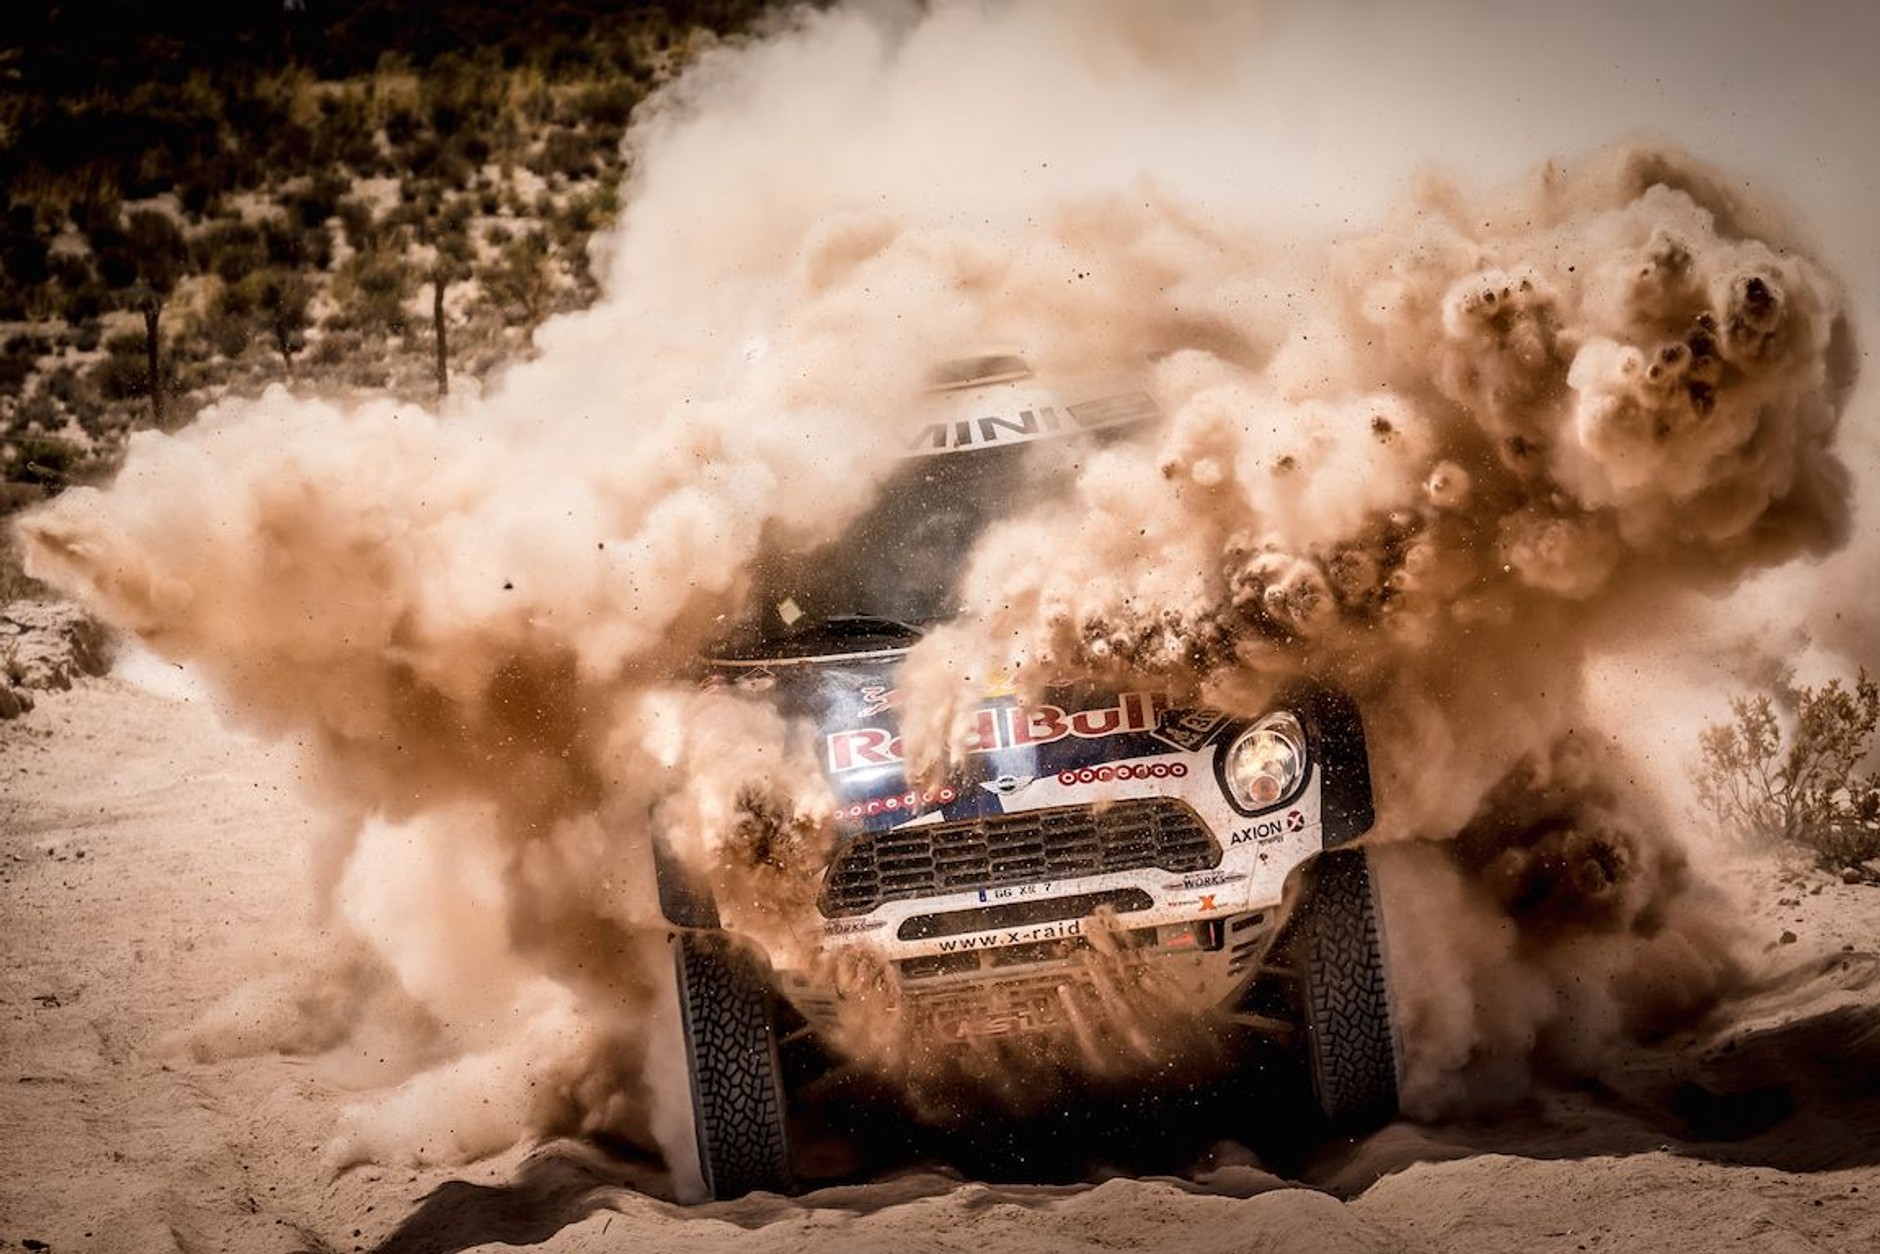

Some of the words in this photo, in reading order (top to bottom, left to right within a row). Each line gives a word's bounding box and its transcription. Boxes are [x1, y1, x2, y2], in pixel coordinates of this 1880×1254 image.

[1007, 691, 1169, 748] Bull
[1058, 762, 1188, 786] ooredoo
[1230, 820, 1282, 845] AXION
[1183, 875, 1226, 890] WORKS
